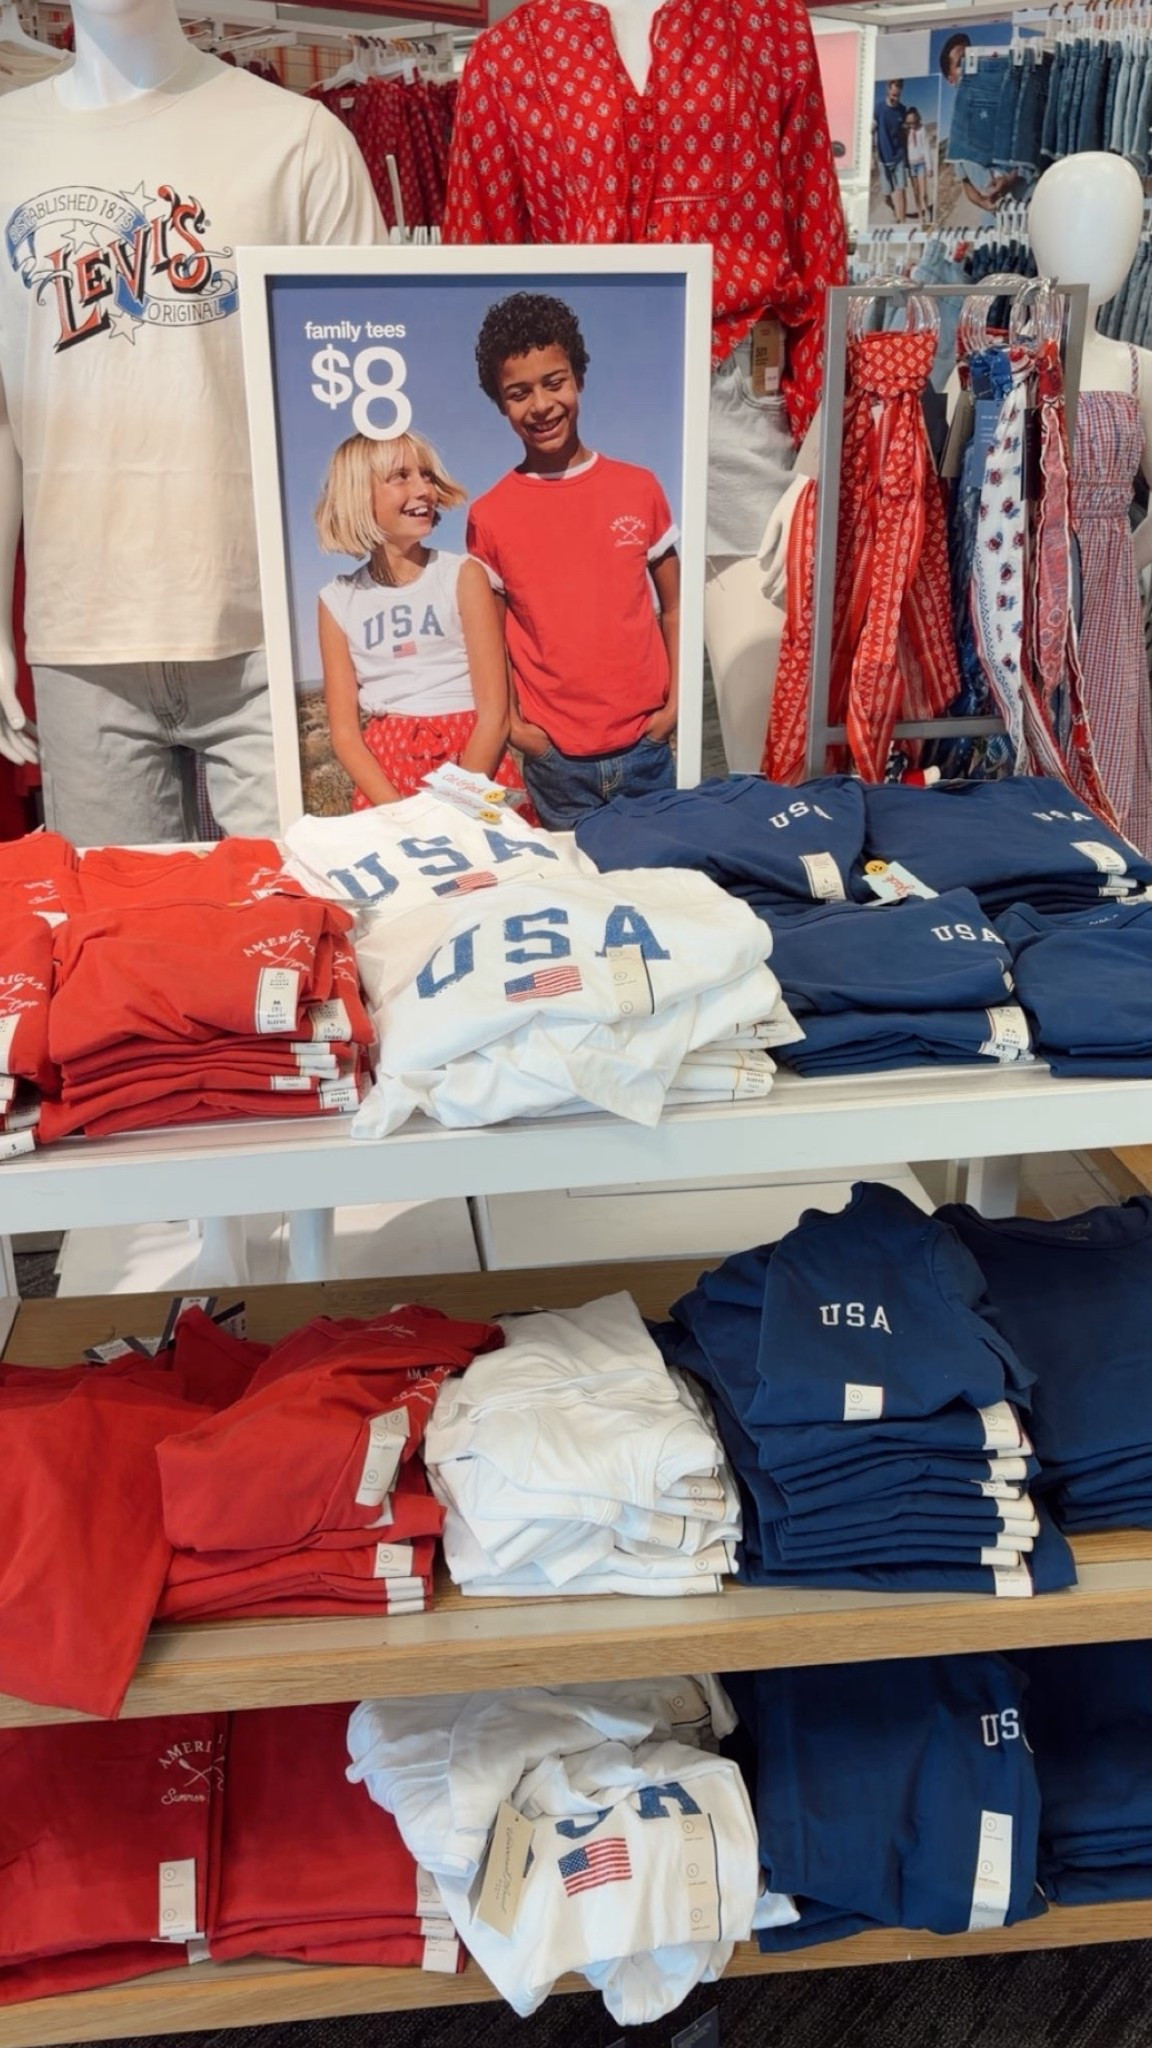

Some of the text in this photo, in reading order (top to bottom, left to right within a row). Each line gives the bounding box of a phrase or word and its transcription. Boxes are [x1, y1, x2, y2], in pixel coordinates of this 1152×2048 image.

[9, 194, 135, 245] ESTABLISHED 1873
[149, 302, 223, 321] ORIGINAL
[304, 321, 406, 340] family tees
[310, 344, 412, 441] $8
[363, 603, 445, 650] USA
[326, 828, 559, 901] USA
[416, 904, 671, 999] USA
[931, 923, 1005, 945] USA
[819, 1302, 893, 1335] USA
[981, 1708, 1033, 1752] US
[158, 1740, 213, 1770] AMERI
